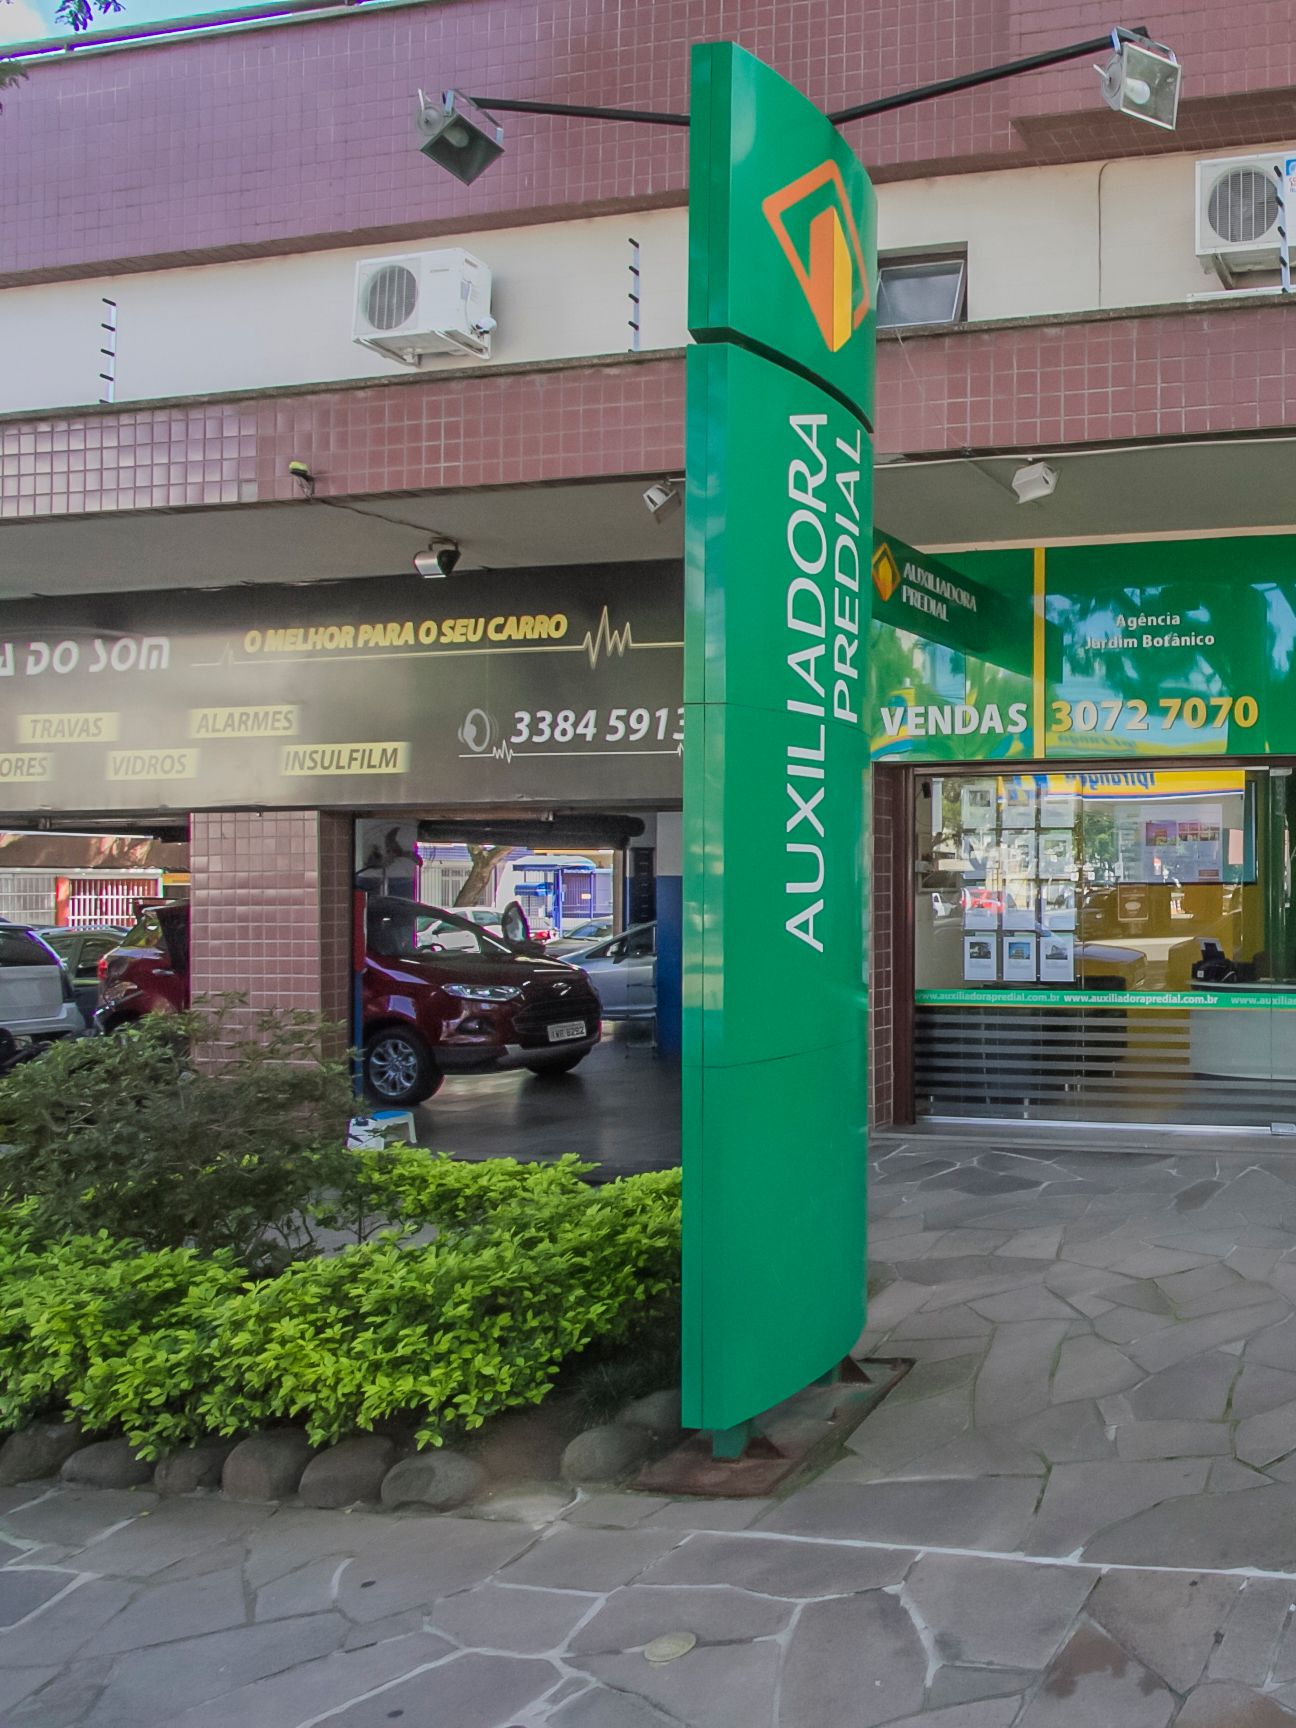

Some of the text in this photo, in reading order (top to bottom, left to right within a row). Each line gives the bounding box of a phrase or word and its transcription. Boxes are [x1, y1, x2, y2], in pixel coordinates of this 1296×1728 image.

[834, 429, 862, 723] PREDIAL
[903, 563, 977, 612] AUXILIADORA
[902, 584, 949, 622] PREDIAL
[244, 614, 568, 653] O MELHOR PARA O SEU CARRO
[1116, 612, 1181, 630] Agência
[1085, 632, 1215, 649] Jardim Botânico
[26, 641, 79, 675] DO
[785, 413, 829, 953] AUXILIADORA
[30, 717, 104, 739] TRAVAS
[196, 710, 294, 734] ALARMES
[510, 709, 598, 744] 3384
[880, 695, 1260, 737] VENDAS 3072 7070
[112, 754, 187, 776] VIDROS
[283, 747, 399, 771] INSULFILM
[1063, 993, 1219, 1006] www.auxiliadorapredial.com.br
